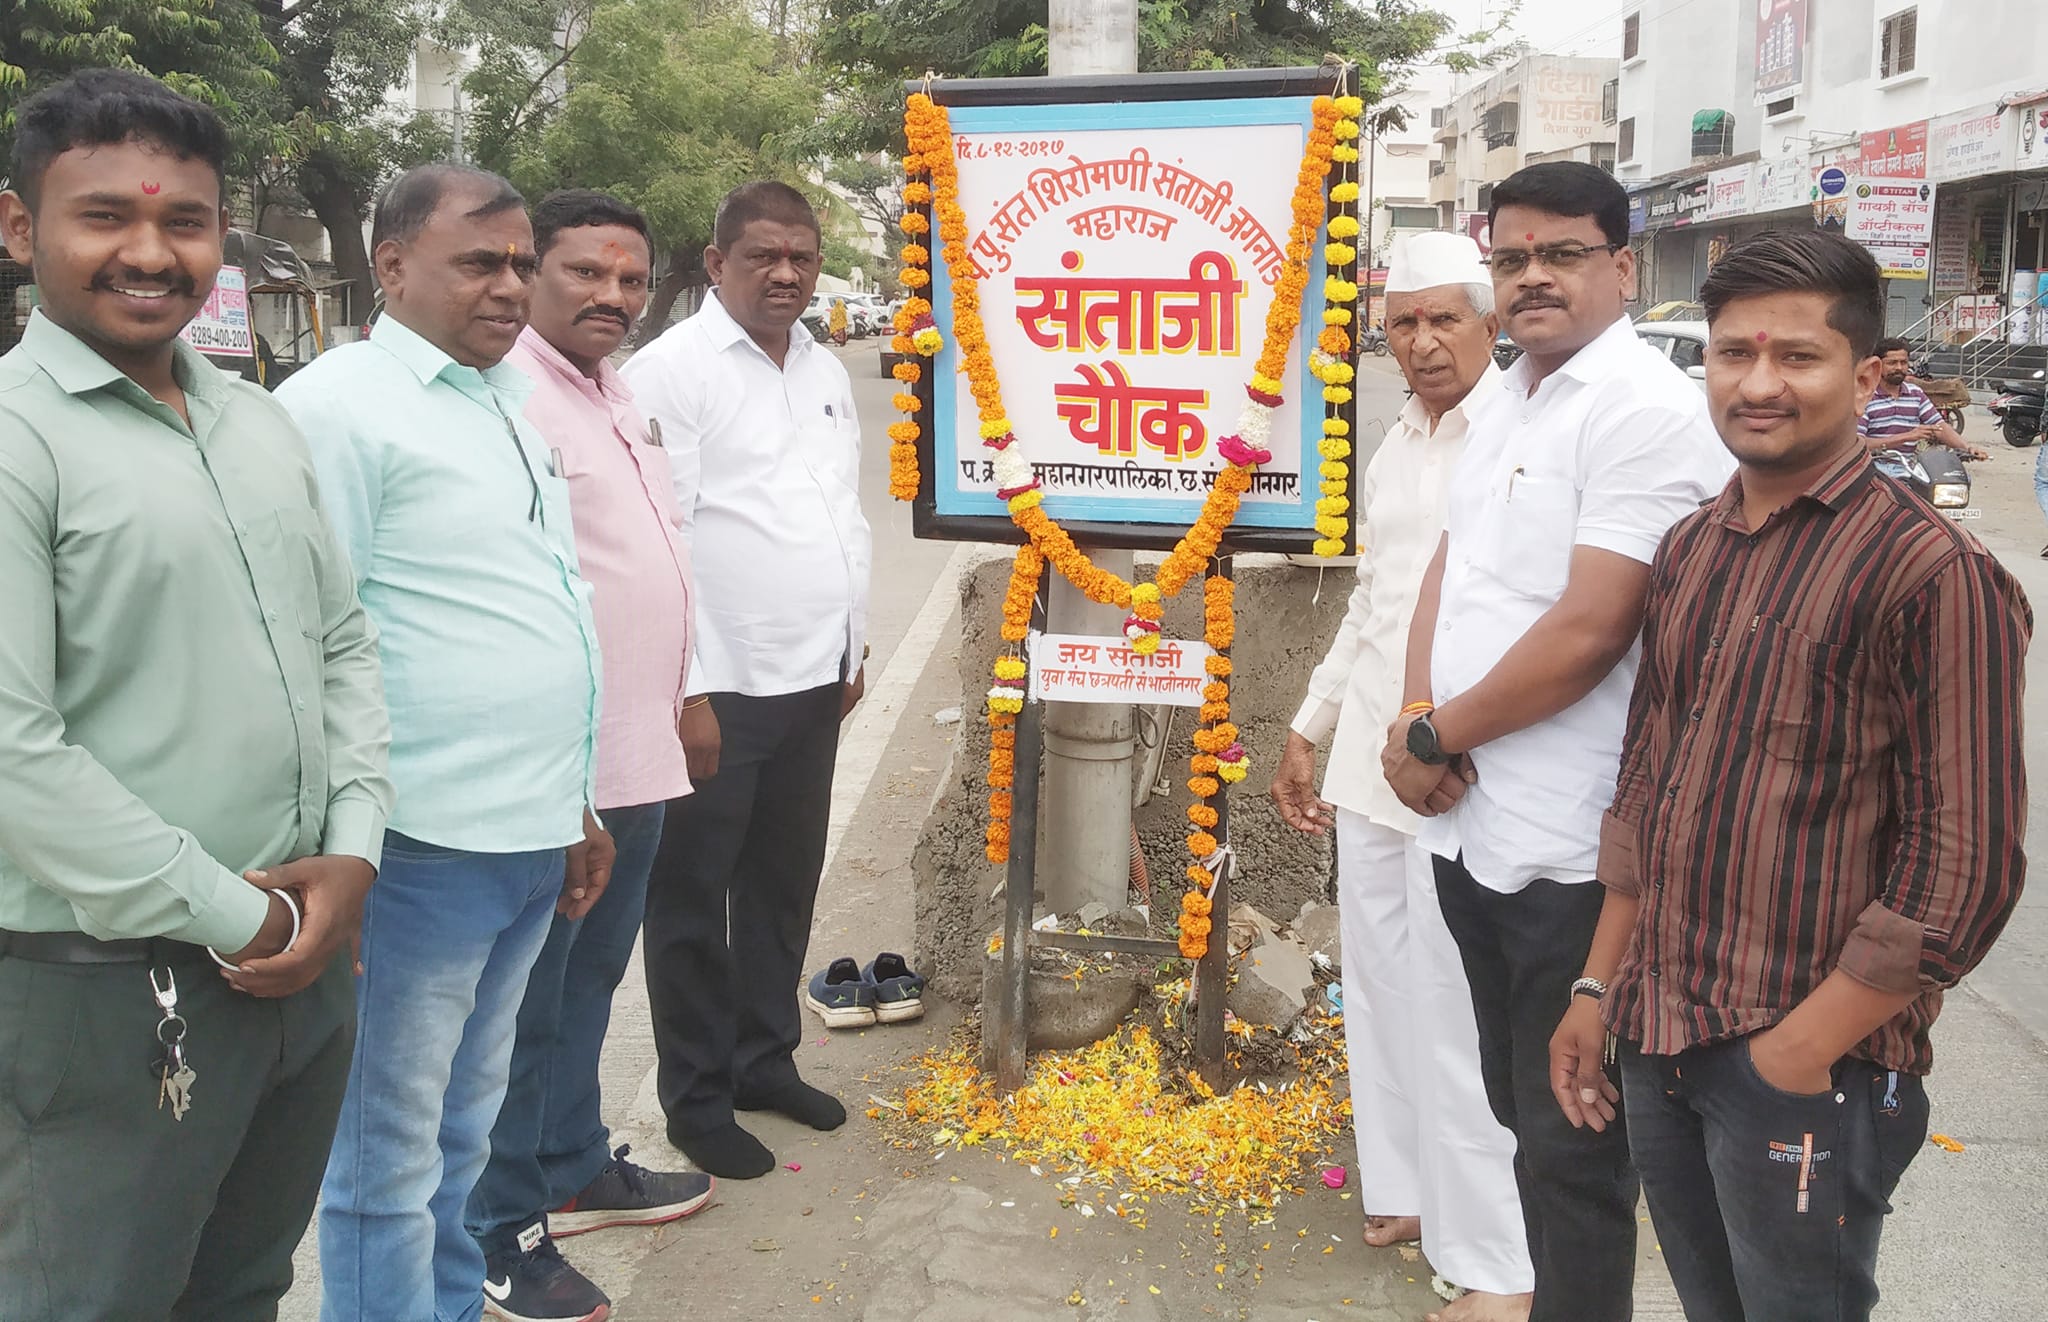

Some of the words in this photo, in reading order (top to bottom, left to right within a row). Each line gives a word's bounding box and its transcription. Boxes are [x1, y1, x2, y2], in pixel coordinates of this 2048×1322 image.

[1027, 147, 1153, 213] शिरोमणी
[1152, 157, 1234, 226] संताजी
[1889, 187, 1914, 195] TITAN
[1857, 200, 1897, 213] गायत्री
[1902, 199, 1929, 214] वॉच
[1066, 204, 1178, 242] महाराज
[1857, 218, 1926, 233] ऑप्टीकल्स
[1014, 250, 1249, 356] संताजी
[191, 325, 249, 349] 9289-400-200
[1054, 360, 1211, 462] चौक
[1057, 643, 1101, 665] जय
[1106, 642, 1183, 669] संताजी
[1041, 668, 1066, 692] युवा
[1067, 665, 1087, 688] मंच
[1088, 668, 1135, 692] छत्रपती
[1768, 1150, 1831, 1163] GENERTION
[523, 1228, 541, 1242] NIKE
